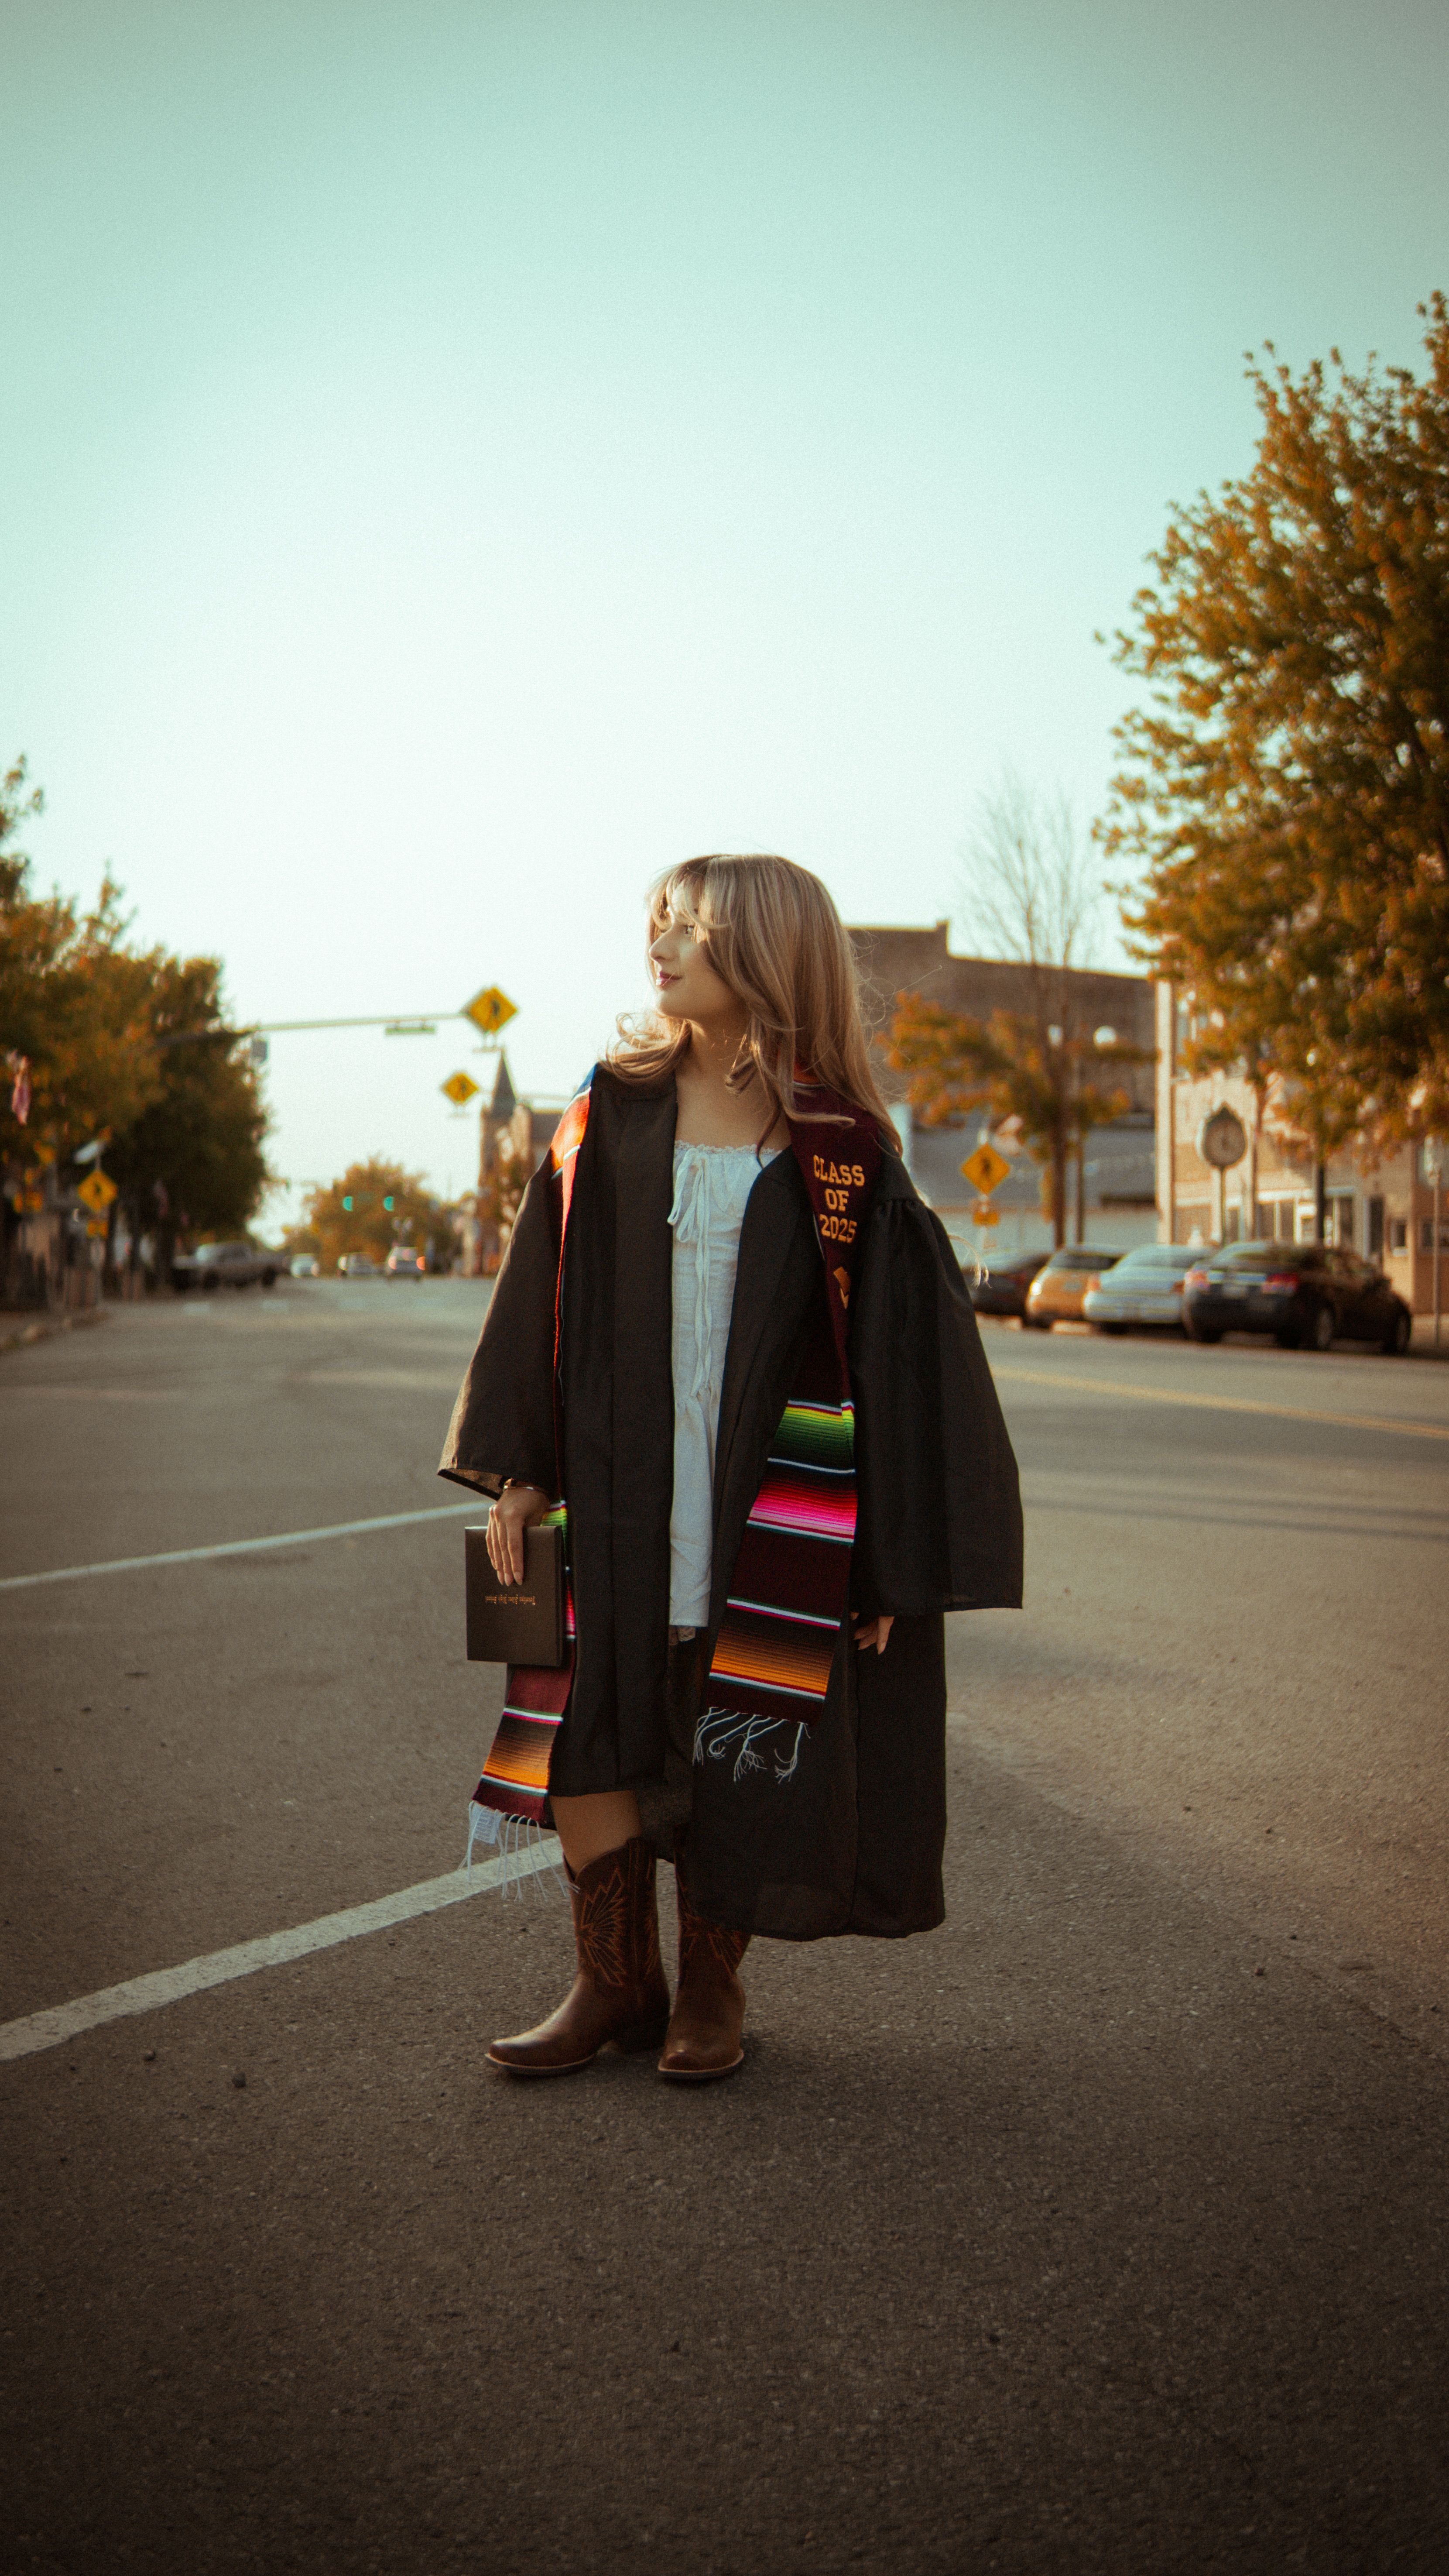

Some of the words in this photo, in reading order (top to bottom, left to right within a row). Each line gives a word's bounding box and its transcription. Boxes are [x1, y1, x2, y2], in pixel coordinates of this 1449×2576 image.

[813, 1155, 865, 1186] CLASS
[825, 1188, 849, 1211] OF
[819, 1214, 857, 1243] 2025
